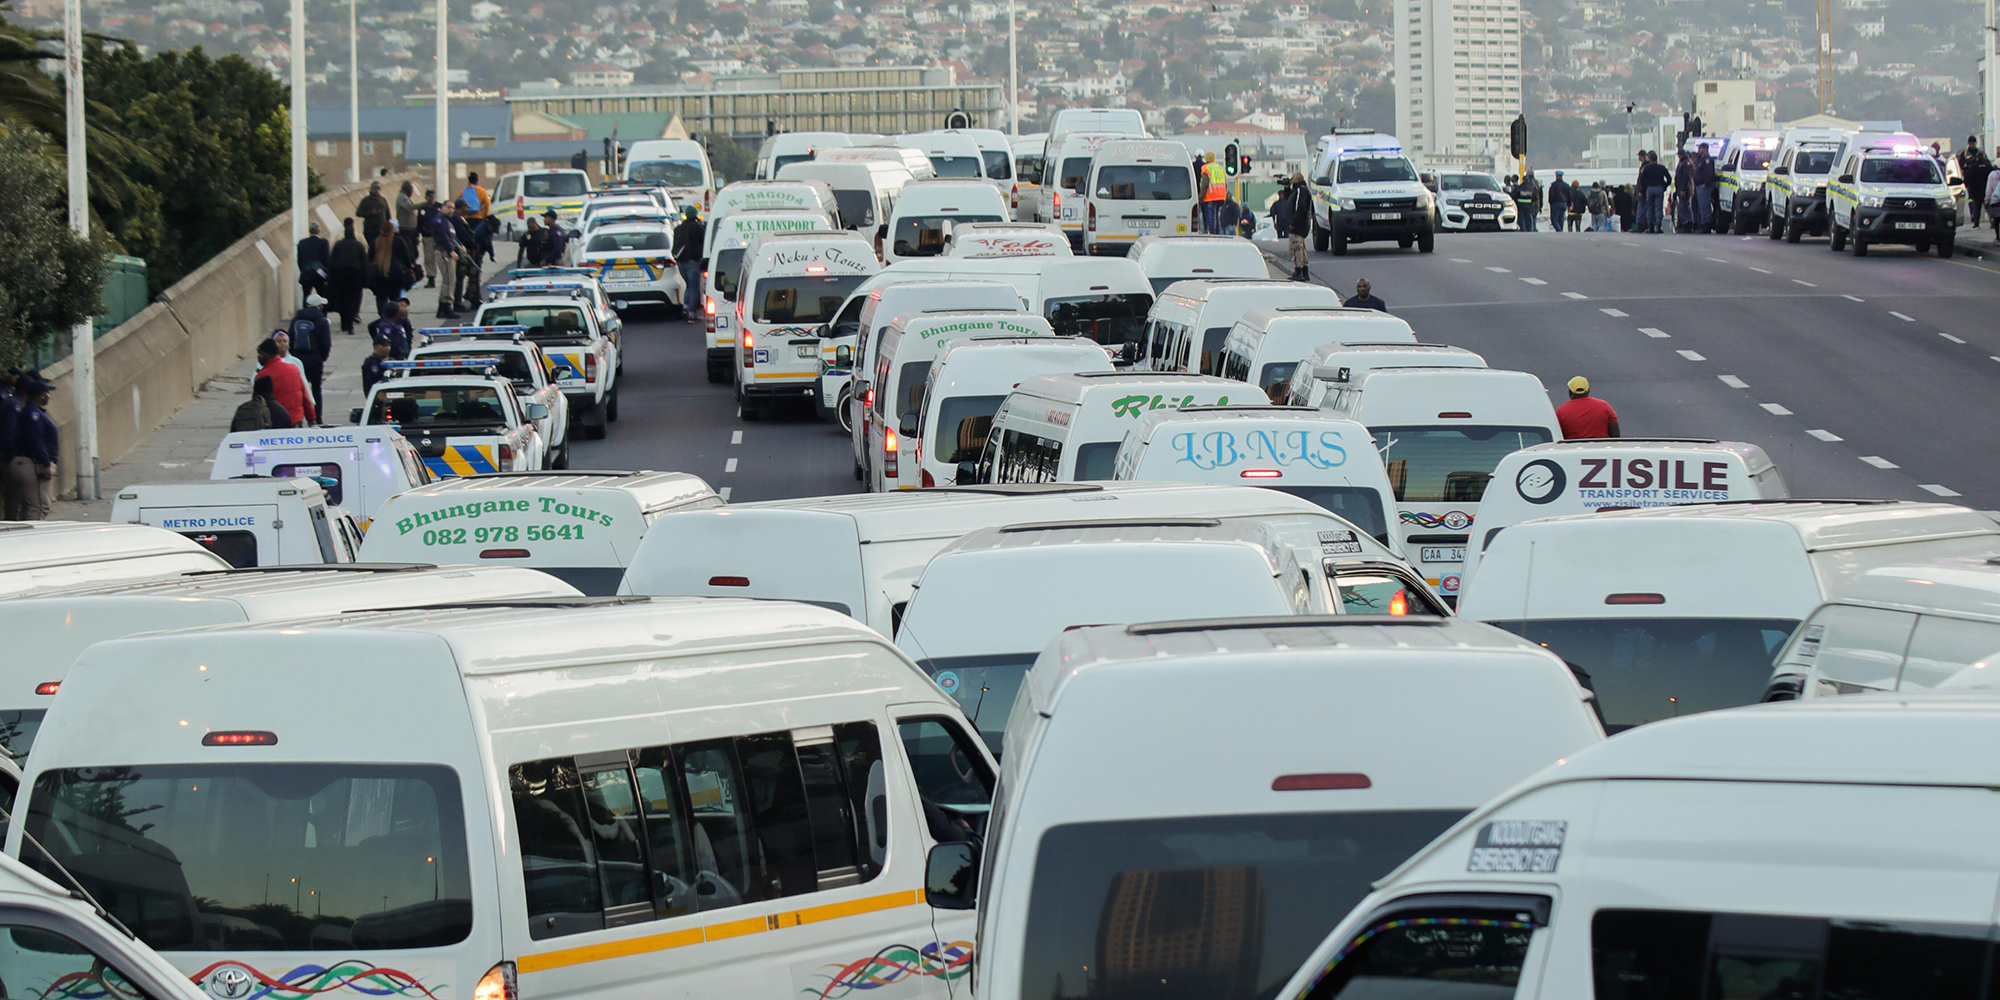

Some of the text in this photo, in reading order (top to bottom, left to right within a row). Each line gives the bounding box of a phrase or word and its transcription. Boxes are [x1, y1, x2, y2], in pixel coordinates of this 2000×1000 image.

[745, 191, 804, 207] MAGODA
[766, 246, 867, 275] Neku's Tours
[920, 320, 1039, 340] Bhungane Tours
[259, 434, 354, 446] METRO POLICE
[1578, 458, 1729, 491] ZISILE
[1579, 489, 1729, 501] TRANSPORT SERVICES
[163, 516, 255, 528] METRO POLICE
[395, 497, 614, 536] Bhungane Tours
[423, 524, 585, 546] 082 978 5641
[1424, 549, 1442, 560] CAA
